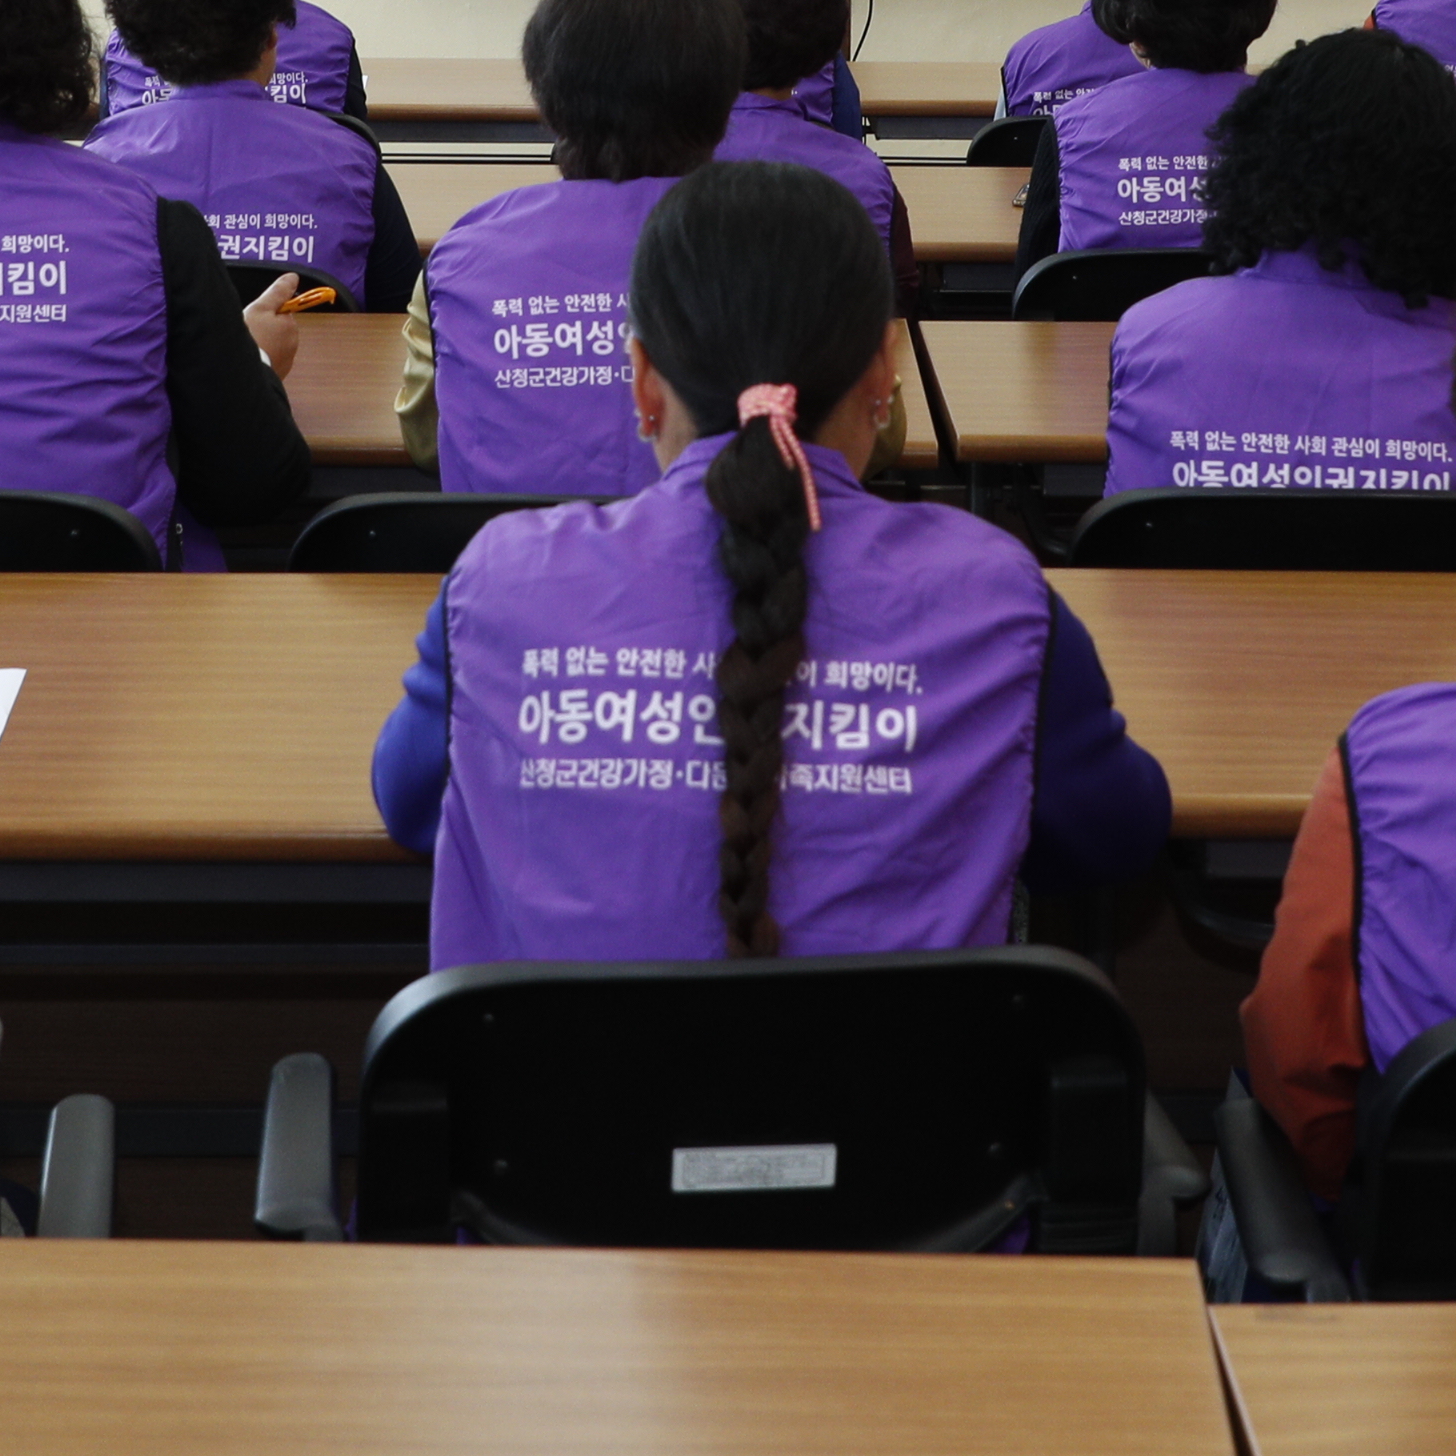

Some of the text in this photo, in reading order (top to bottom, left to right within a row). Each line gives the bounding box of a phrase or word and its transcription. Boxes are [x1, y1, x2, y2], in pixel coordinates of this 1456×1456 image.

[265, 83, 307, 104] 킴이
[1118, 157, 1142, 171] 폭력
[1146, 156, 1170, 171] 없는
[1173, 155, 1209, 170] 안전한
[224, 214, 261, 229] 관심이
[264, 213, 319, 229] 희망이다.
[1119, 208, 1217, 226] 산청군건강가정·
[1, 232, 71, 254] 희망이다.
[215, 233, 314, 263] 권지킴이
[492, 297, 523, 318] 폭력
[528, 295, 560, 316] 없는
[564, 292, 613, 313] 안전한
[1170, 430, 1454, 463] 폭력 없는 안전한 사회 관심이 희망이다.
[522, 648, 559, 679] 폭력
[565, 646, 609, 677] 없는
[615, 646, 687, 680] 안전한
[824, 660, 924, 695] 희망이다.
